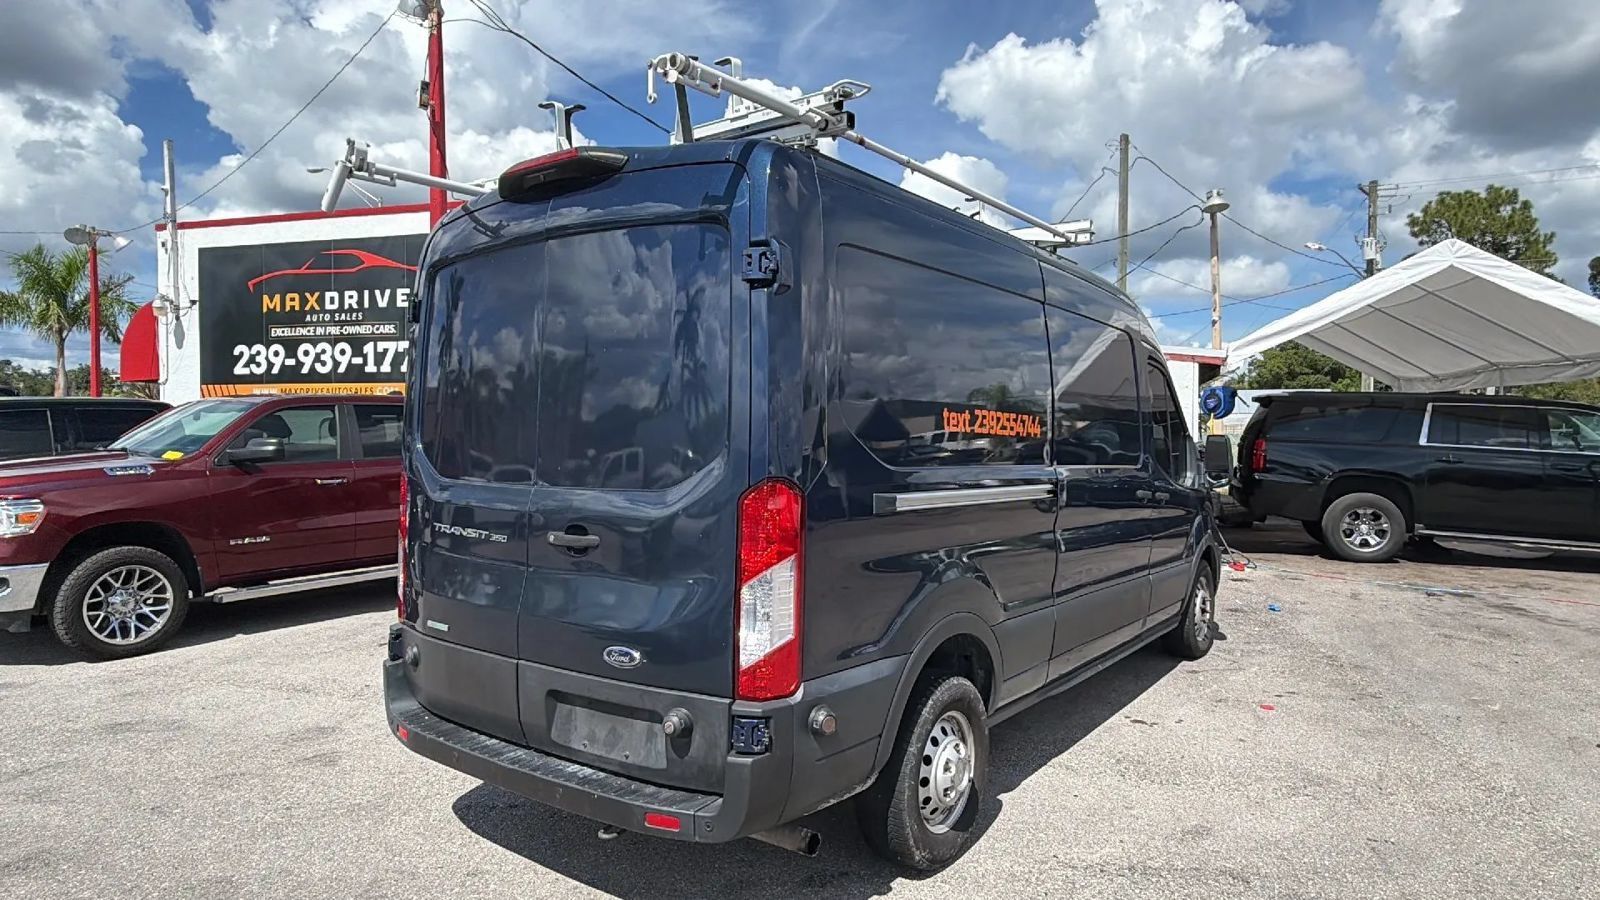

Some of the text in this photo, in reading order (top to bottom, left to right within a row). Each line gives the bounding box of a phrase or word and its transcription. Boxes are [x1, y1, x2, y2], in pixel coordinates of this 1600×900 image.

[262, 288, 411, 313] MAXDRIVE
[305, 312, 363, 322] AUTO SALES
[271, 324, 397, 337] EXCELLENCE IN PRE-OWNED CARS.
[233, 341, 409, 375] 239-939-177
[943, 407, 1041, 438] text 2392554744
[433, 522, 508, 543] TRANSIT 350
